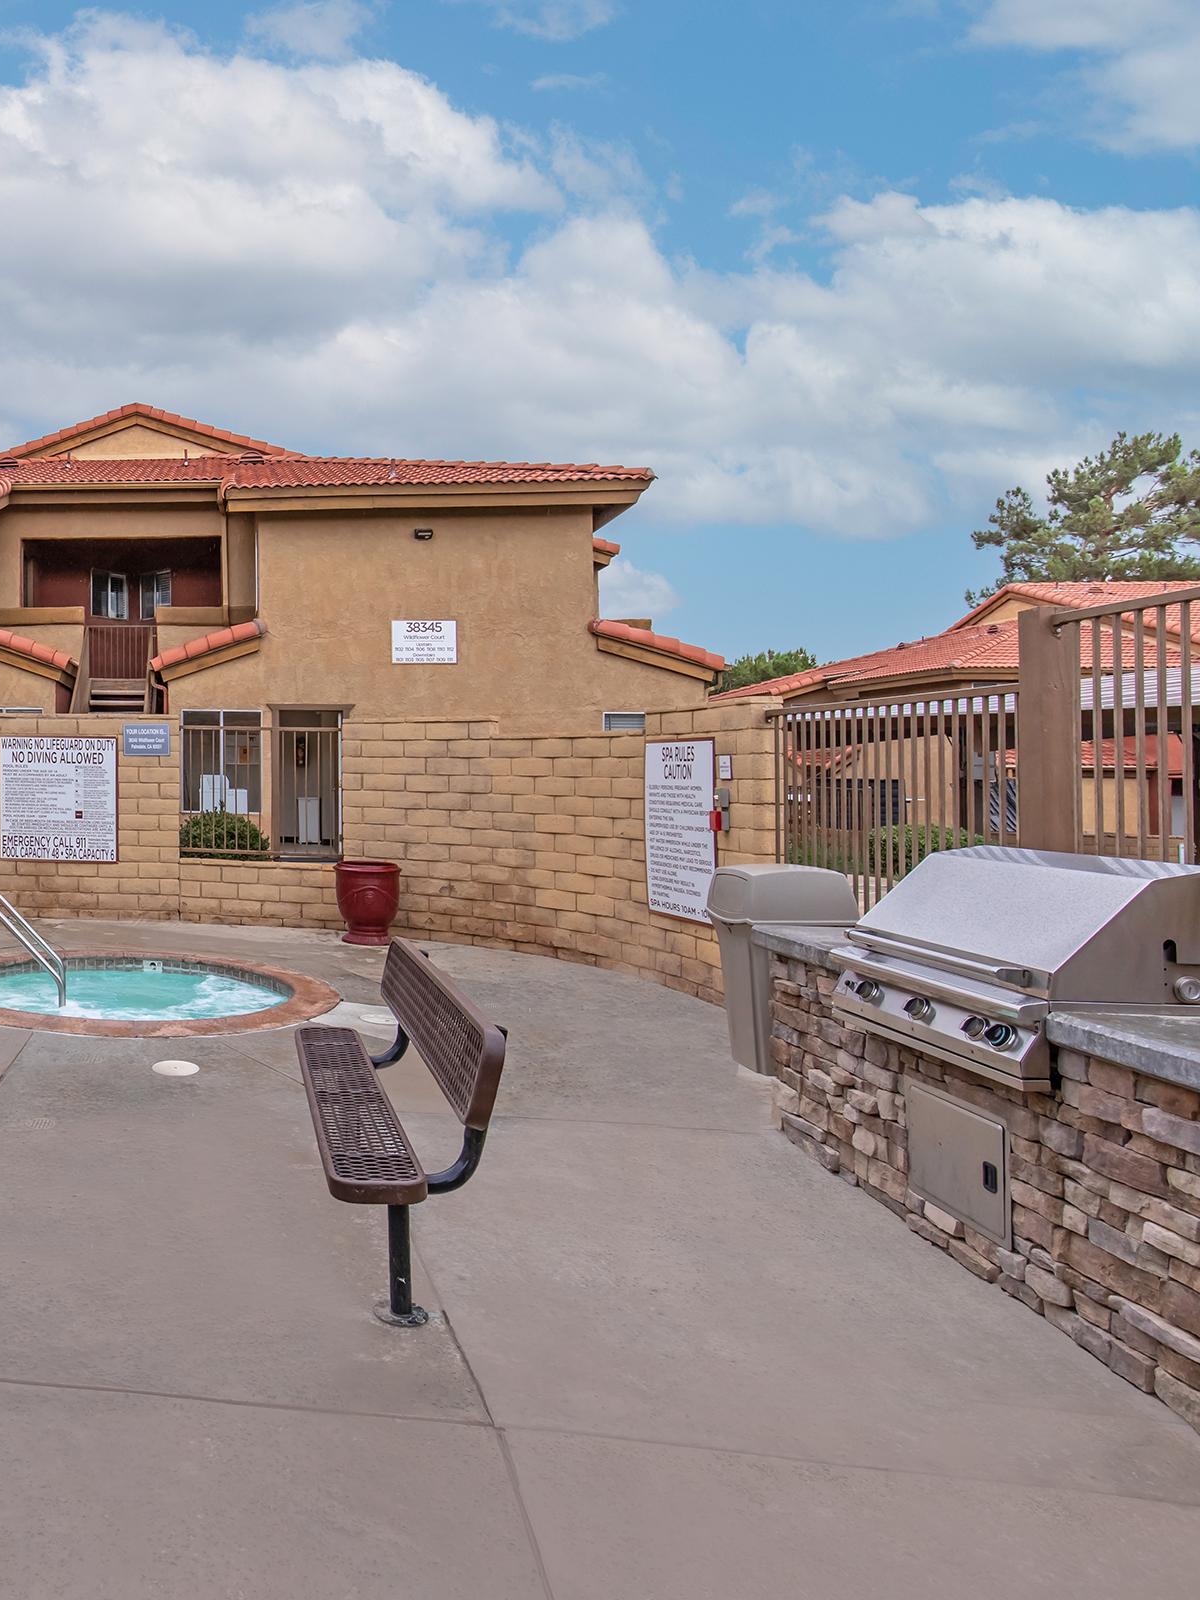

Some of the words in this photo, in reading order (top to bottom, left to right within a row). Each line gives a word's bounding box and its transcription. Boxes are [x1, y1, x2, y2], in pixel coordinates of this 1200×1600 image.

[406, 622, 442, 632] 38345
[2, 739, 33, 750] WARNING
[35, 739, 44, 750] NO
[46, 739, 82, 750] LIFEGUARD
[85, 739, 95, 750] ON
[97, 740, 114, 751] DUTY
[12, 752, 24, 763] NO
[27, 752, 57, 763] DIVING
[60, 752, 104, 764] ALLOWED
[662, 747, 673, 762] SPA
[675, 746, 694, 761] RULES
[664, 764, 692, 780] CAUTION
[2, 835, 51, 847] EMERGENCY
[53, 837, 73, 848] CALL
[76, 837, 86, 848] 911
[2, 847, 19, 857] POOL
[20, 847, 50, 858] CAPACITY
[52, 848, 59, 858] 48
[65, 848, 77, 859] SPA
[78, 849, 108, 860] CAPACITY
[110, 850, 114, 860] 6
[650, 898, 661, 907] SPA
[662, 901, 680, 911] HOURS
[681, 905, 696, 915] 10AM
